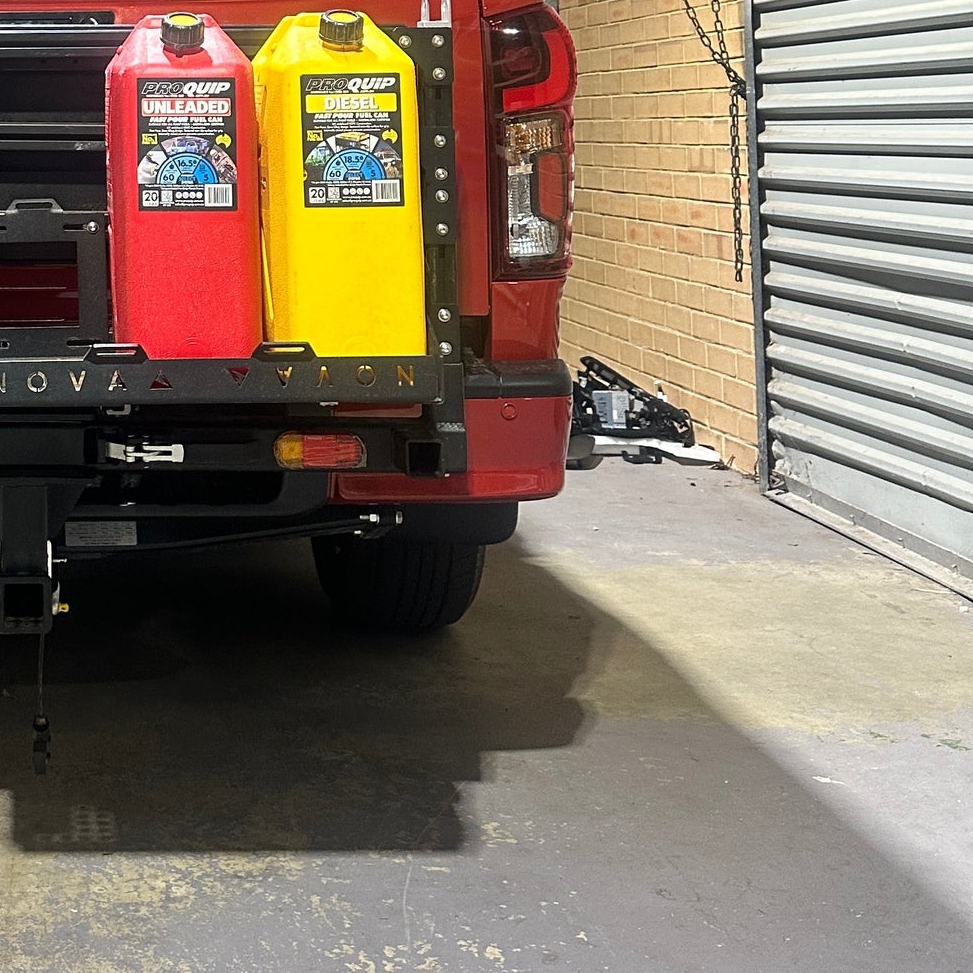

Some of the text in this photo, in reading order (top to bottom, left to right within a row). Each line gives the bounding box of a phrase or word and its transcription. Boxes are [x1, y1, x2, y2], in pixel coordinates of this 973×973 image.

[141, 82, 231, 98] PROQUIP
[306, 77, 396, 93] PROQUIP
[143, 100, 229, 115] UNLEADED
[324, 96, 379, 111] DIESEL
[162, 174, 175, 182] 60
[329, 170, 342, 178] 60
[370, 169, 376, 177] 5
[144, 191, 158, 202] 20
[310, 188, 325, 199] 20
